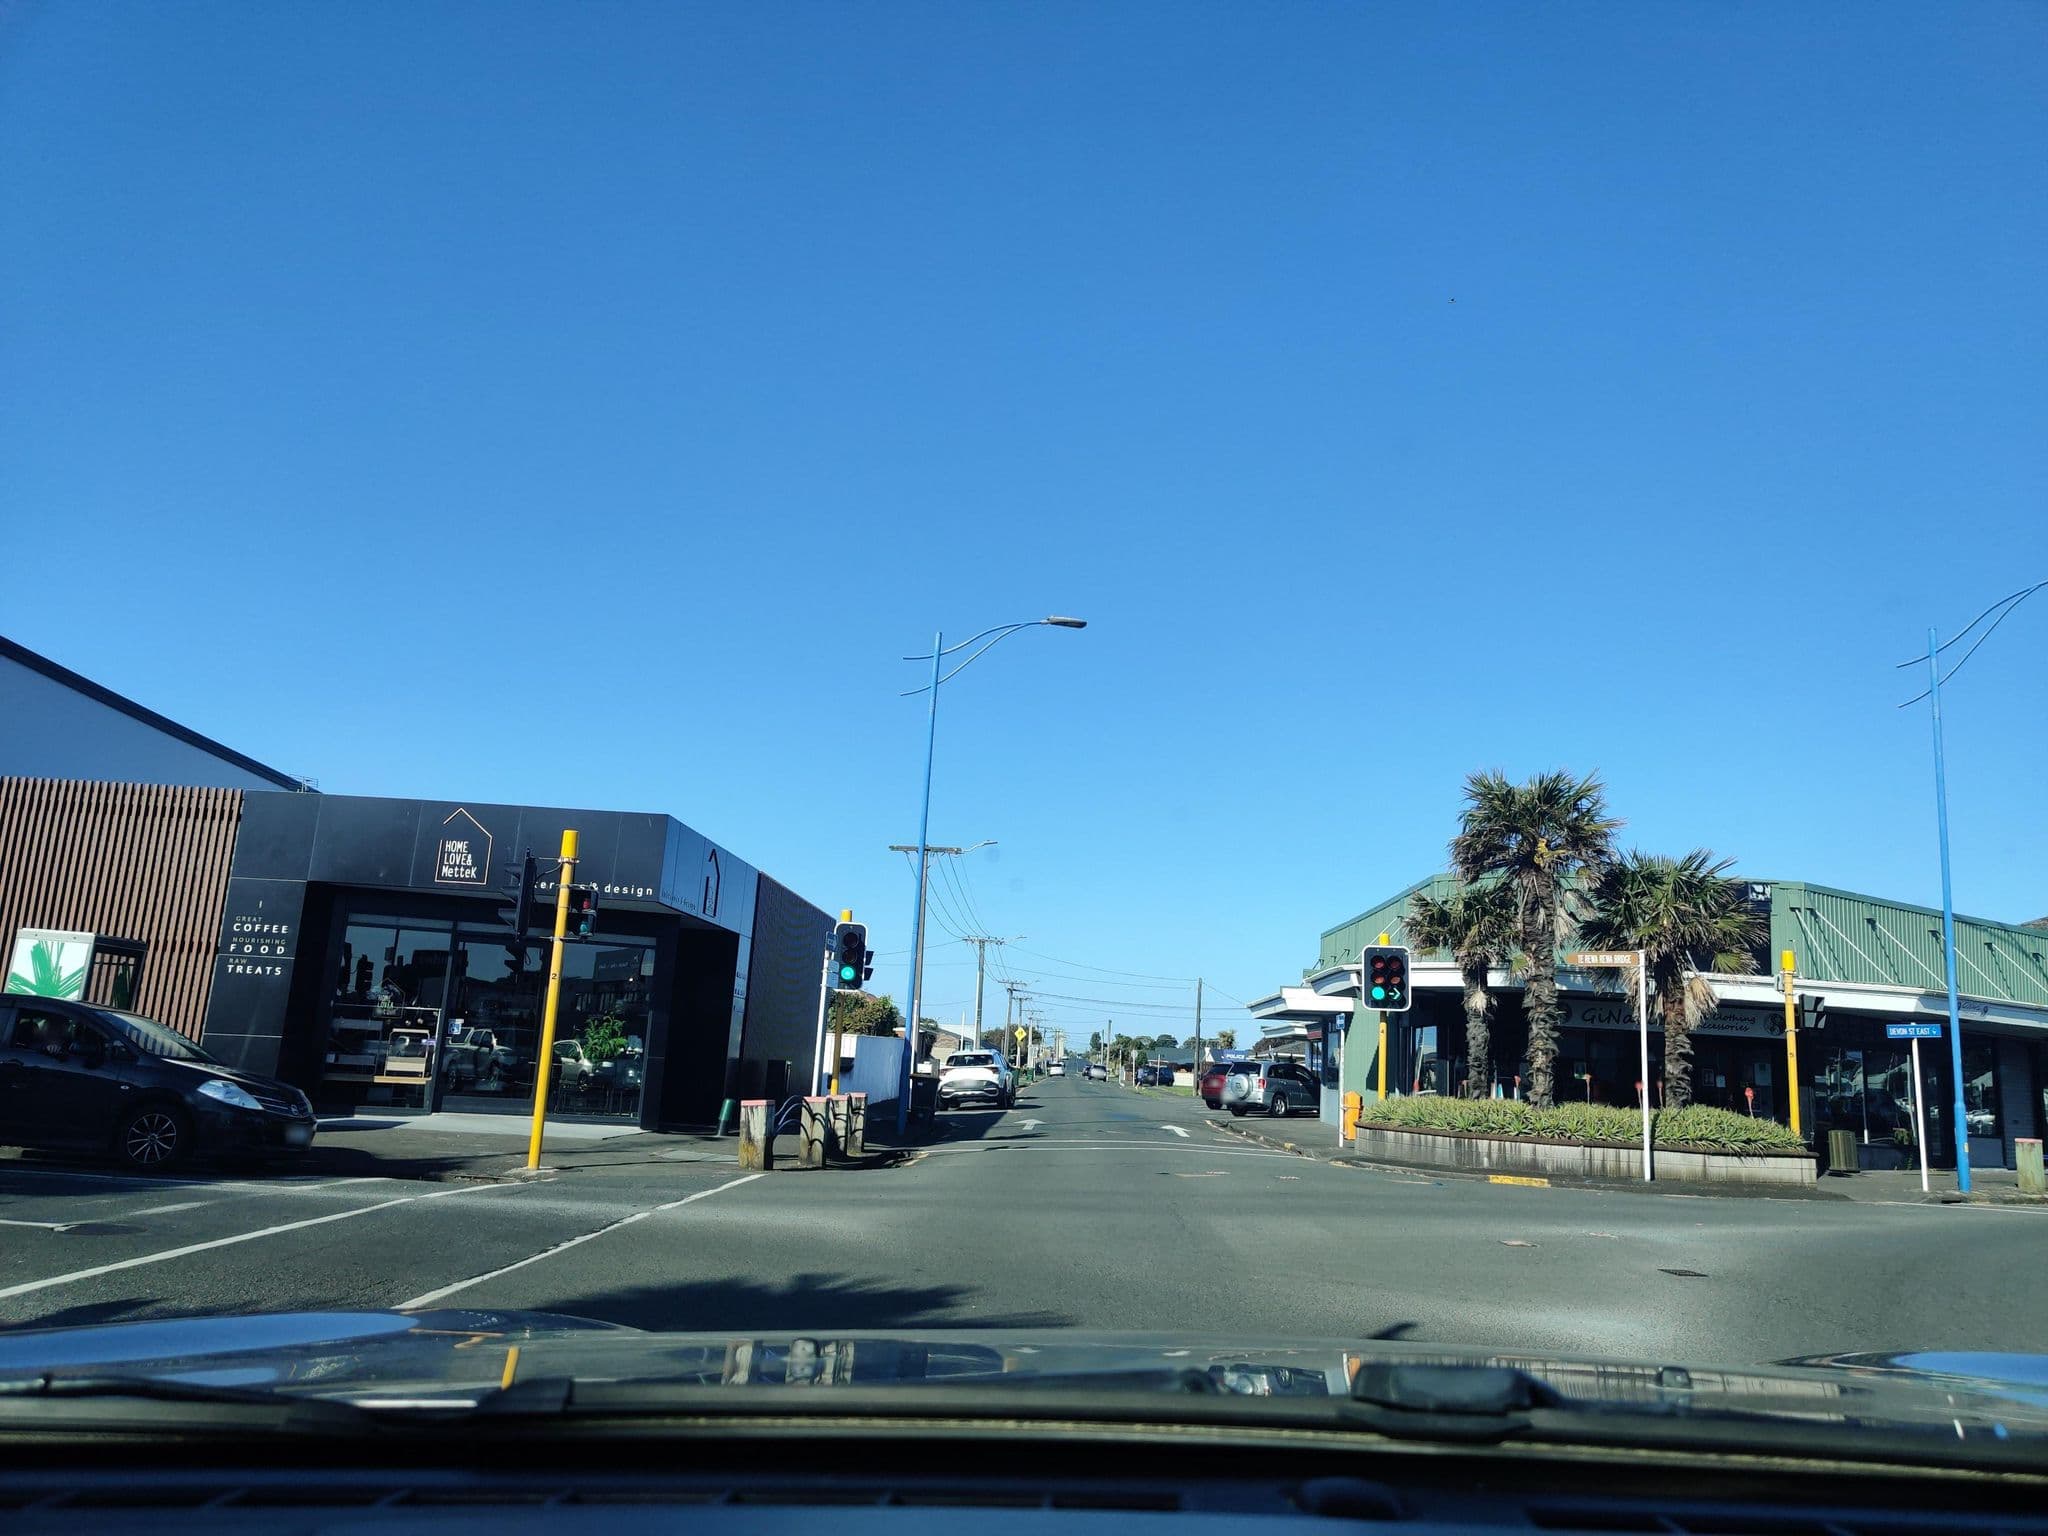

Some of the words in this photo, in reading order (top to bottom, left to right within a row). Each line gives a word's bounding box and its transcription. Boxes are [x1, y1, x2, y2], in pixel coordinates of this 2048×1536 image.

[445, 840, 469, 853] HOME
[443, 853, 472, 866] LOVE&
[441, 865, 477, 879] MetteK
[604, 883, 653, 896] design
[233, 923, 289, 934] COFFEE
[232, 937, 287, 945] NOURISHING
[230, 943, 285, 954] FOOD
[227, 964, 282, 976] TREATS
[1916, 1027, 1930, 1035] EAST
